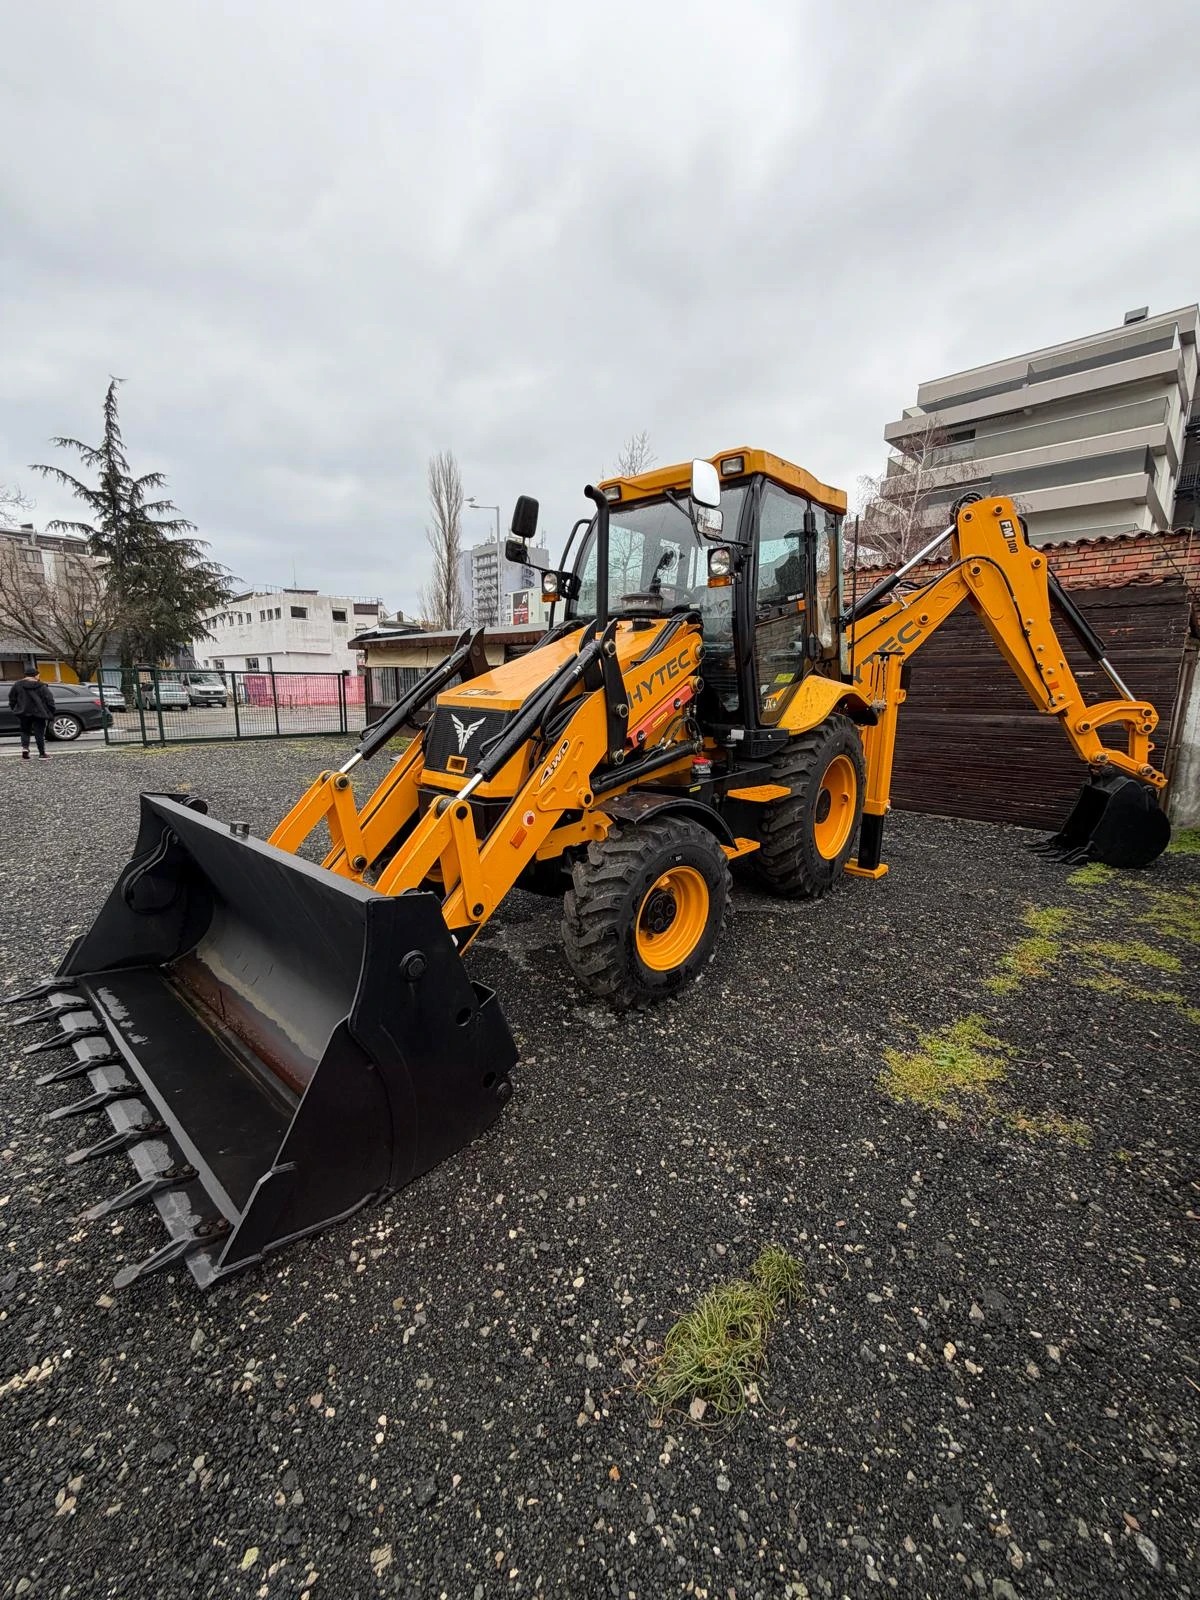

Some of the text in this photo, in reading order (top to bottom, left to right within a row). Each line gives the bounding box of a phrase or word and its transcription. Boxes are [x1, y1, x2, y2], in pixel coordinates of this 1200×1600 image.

[1000, 520, 1019, 553] FM 100
[627, 649, 692, 710] HYTEC
[540, 739, 570, 788] 4WD
